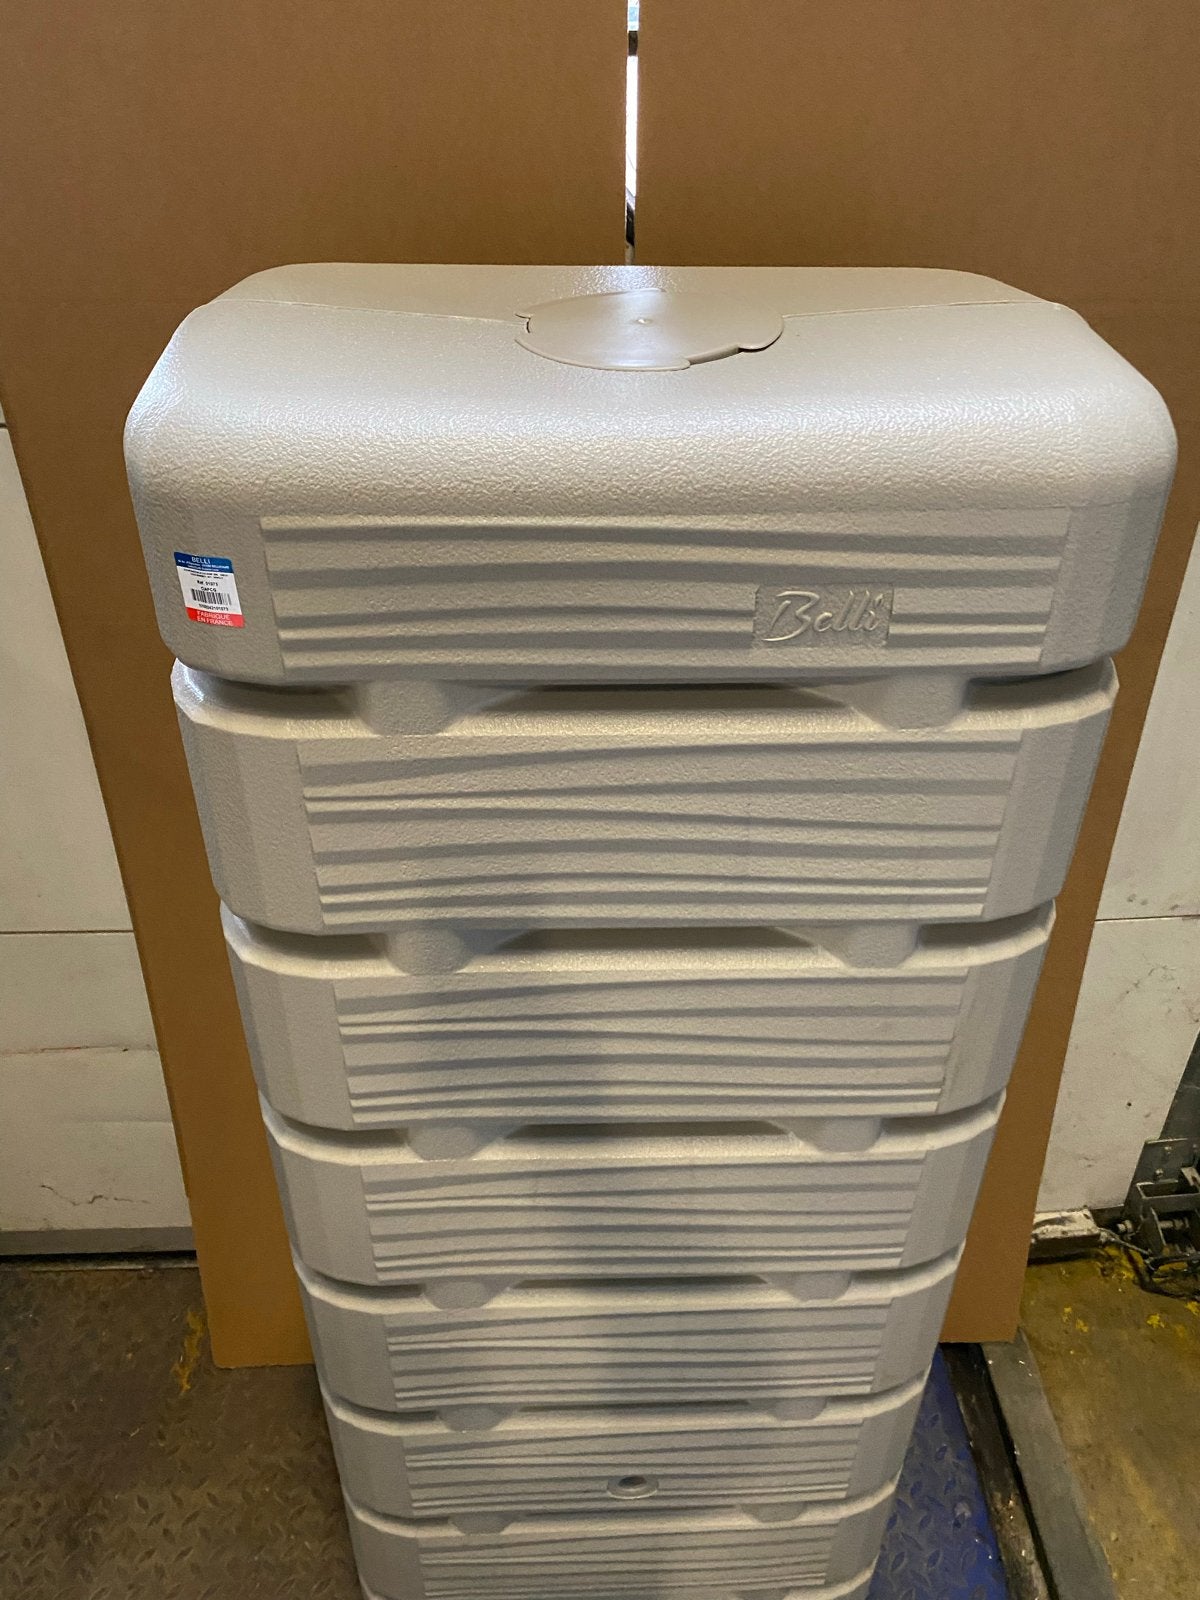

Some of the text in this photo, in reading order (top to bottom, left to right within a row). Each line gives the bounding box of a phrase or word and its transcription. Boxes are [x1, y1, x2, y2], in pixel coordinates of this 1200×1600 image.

[191, 556, 211, 564] BELLI
[196, 610, 231, 620] FABRIQUE
[762, 589, 883, 641] Belli
[206, 617, 234, 626] FRANCE
